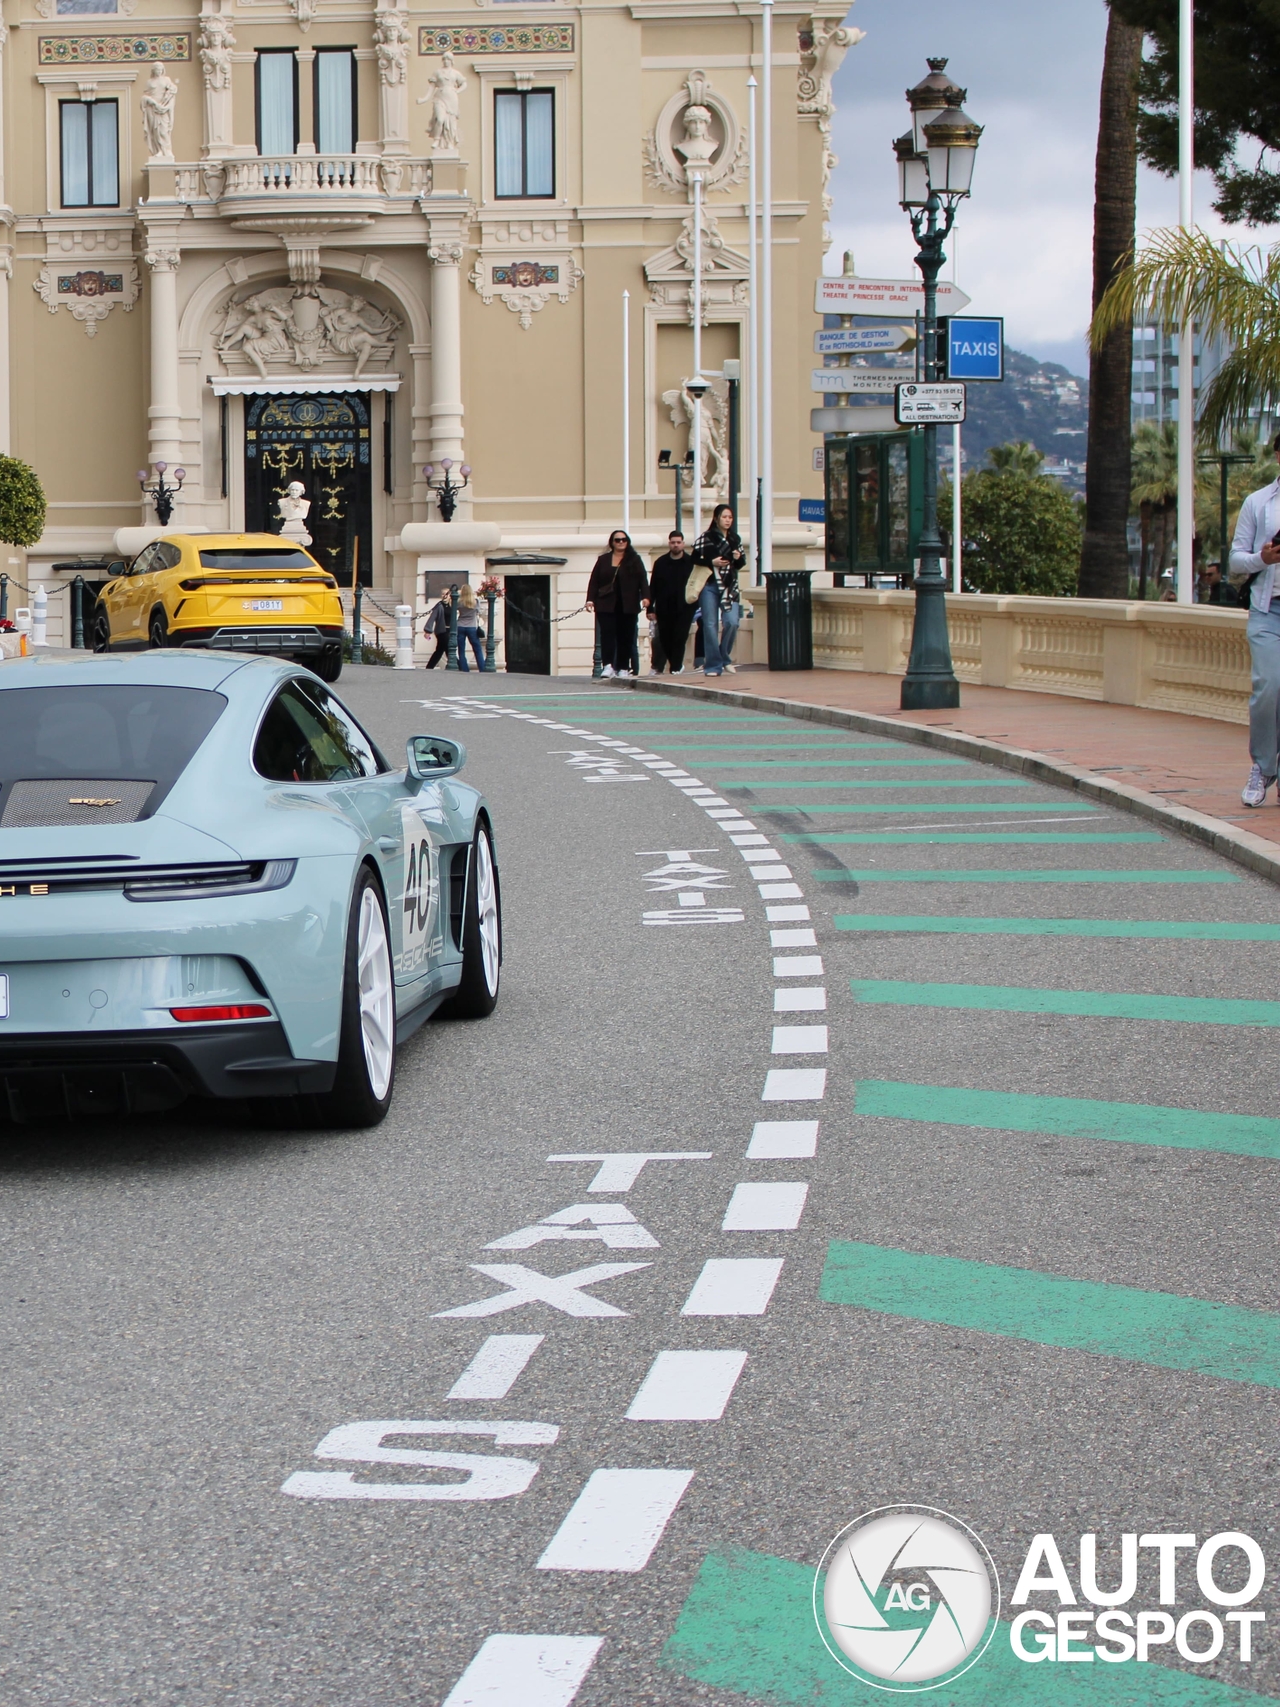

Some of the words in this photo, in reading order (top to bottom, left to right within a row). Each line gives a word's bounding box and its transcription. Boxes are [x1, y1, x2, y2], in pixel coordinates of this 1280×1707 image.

[819, 332, 845, 341] BANQUE
[861, 330, 889, 339] GESTION
[833, 341, 872, 349] ROTHSCHILD
[952, 341, 998, 356] TAXIS
[802, 506, 825, 516] HAVAS
[404, 838, 431, 935] 40
[635, 849, 745, 925] TAXIS
[393, 935, 443, 973] RSCHE
[280, 1152, 713, 1500] TAXIS
